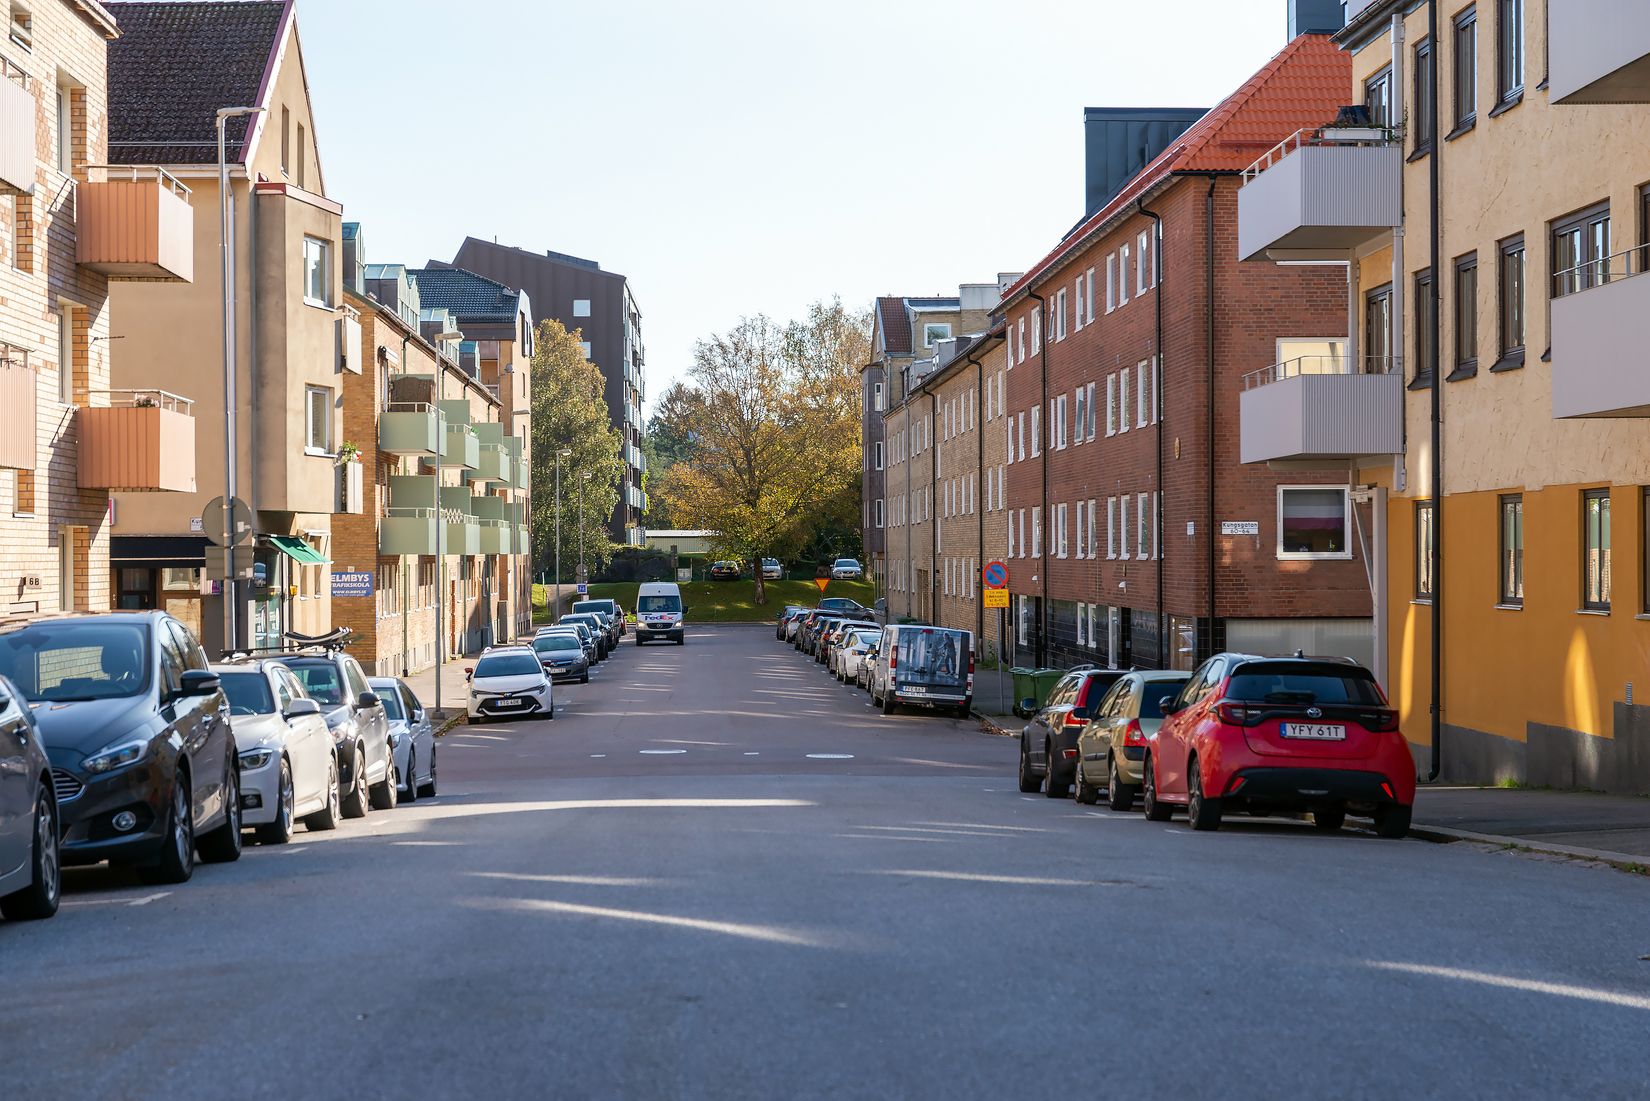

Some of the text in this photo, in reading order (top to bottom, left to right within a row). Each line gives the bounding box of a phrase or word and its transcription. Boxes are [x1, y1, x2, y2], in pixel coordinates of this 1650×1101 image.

[331, 574, 370, 582] ELMBYS
[1290, 725, 1340, 737] YFY 61T
